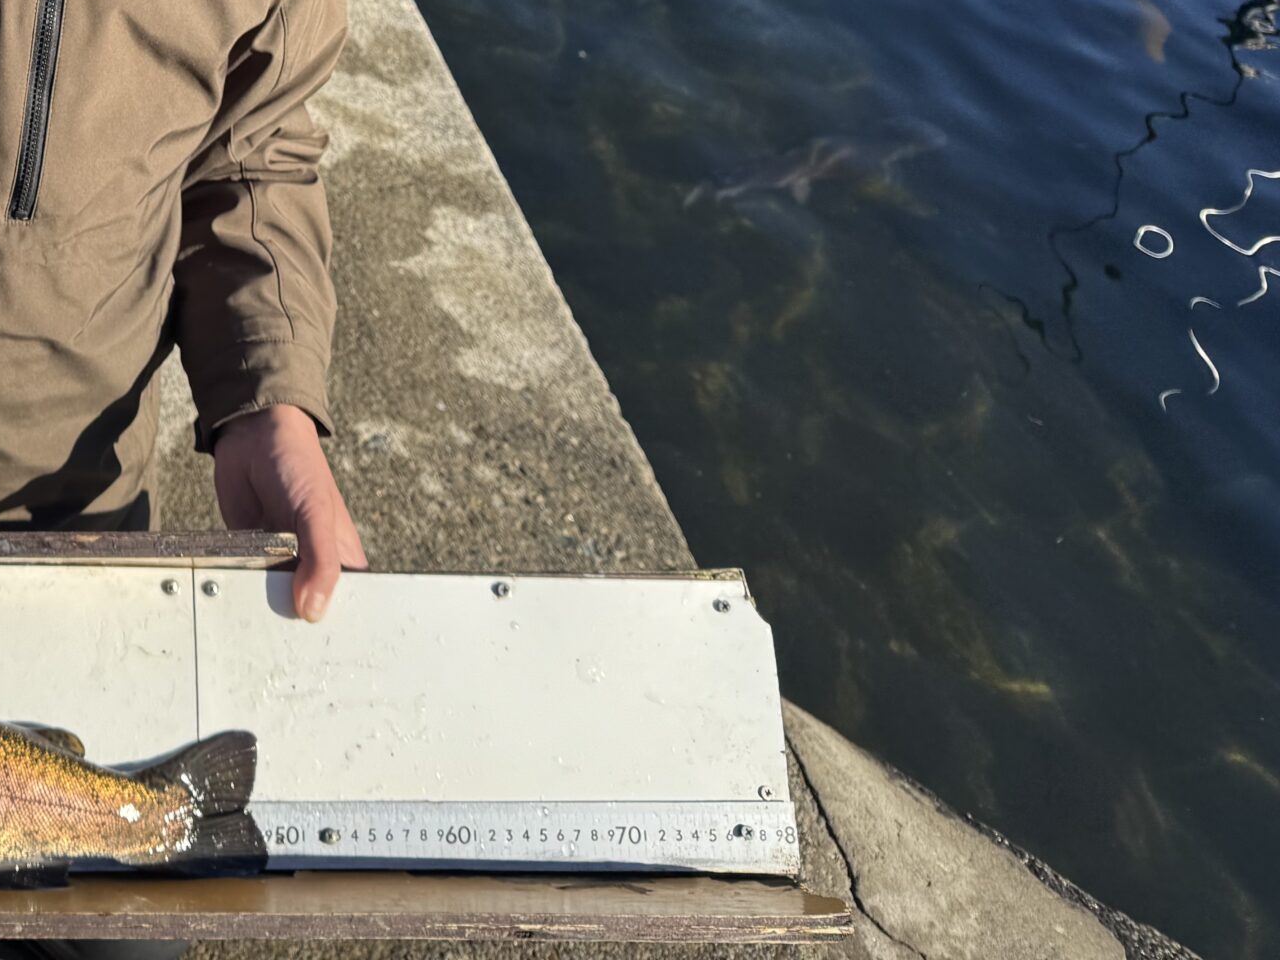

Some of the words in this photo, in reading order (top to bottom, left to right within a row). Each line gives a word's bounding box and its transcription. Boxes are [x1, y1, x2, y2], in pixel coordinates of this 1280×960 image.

[265, 829, 272, 842] 9
[275, 825, 299, 845] 50
[350, 829, 359, 841] 4
[368, 828, 376, 842] 5
[385, 829, 394, 841] 6
[402, 829, 410, 841] 7
[419, 828, 428, 842] 8
[437, 828, 445, 841] 9
[445, 826, 471, 845] 60
[488, 829, 496, 841] 2
[505, 829, 513, 842] 3
[522, 829, 530, 841] 4
[540, 828, 548, 842] 5
[556, 829, 565, 842] 6
[573, 829, 581, 842] 7
[590, 829, 598, 842] 8
[607, 829, 615, 842] 9
[615, 825, 641, 845] 70
[658, 829, 666, 842] 2
[675, 829, 683, 842] 3
[692, 829, 700, 842] 4
[709, 828, 717, 842] 5
[726, 828, 734, 842] 6
[759, 829, 767, 842] 8
[776, 829, 783, 842] 9
